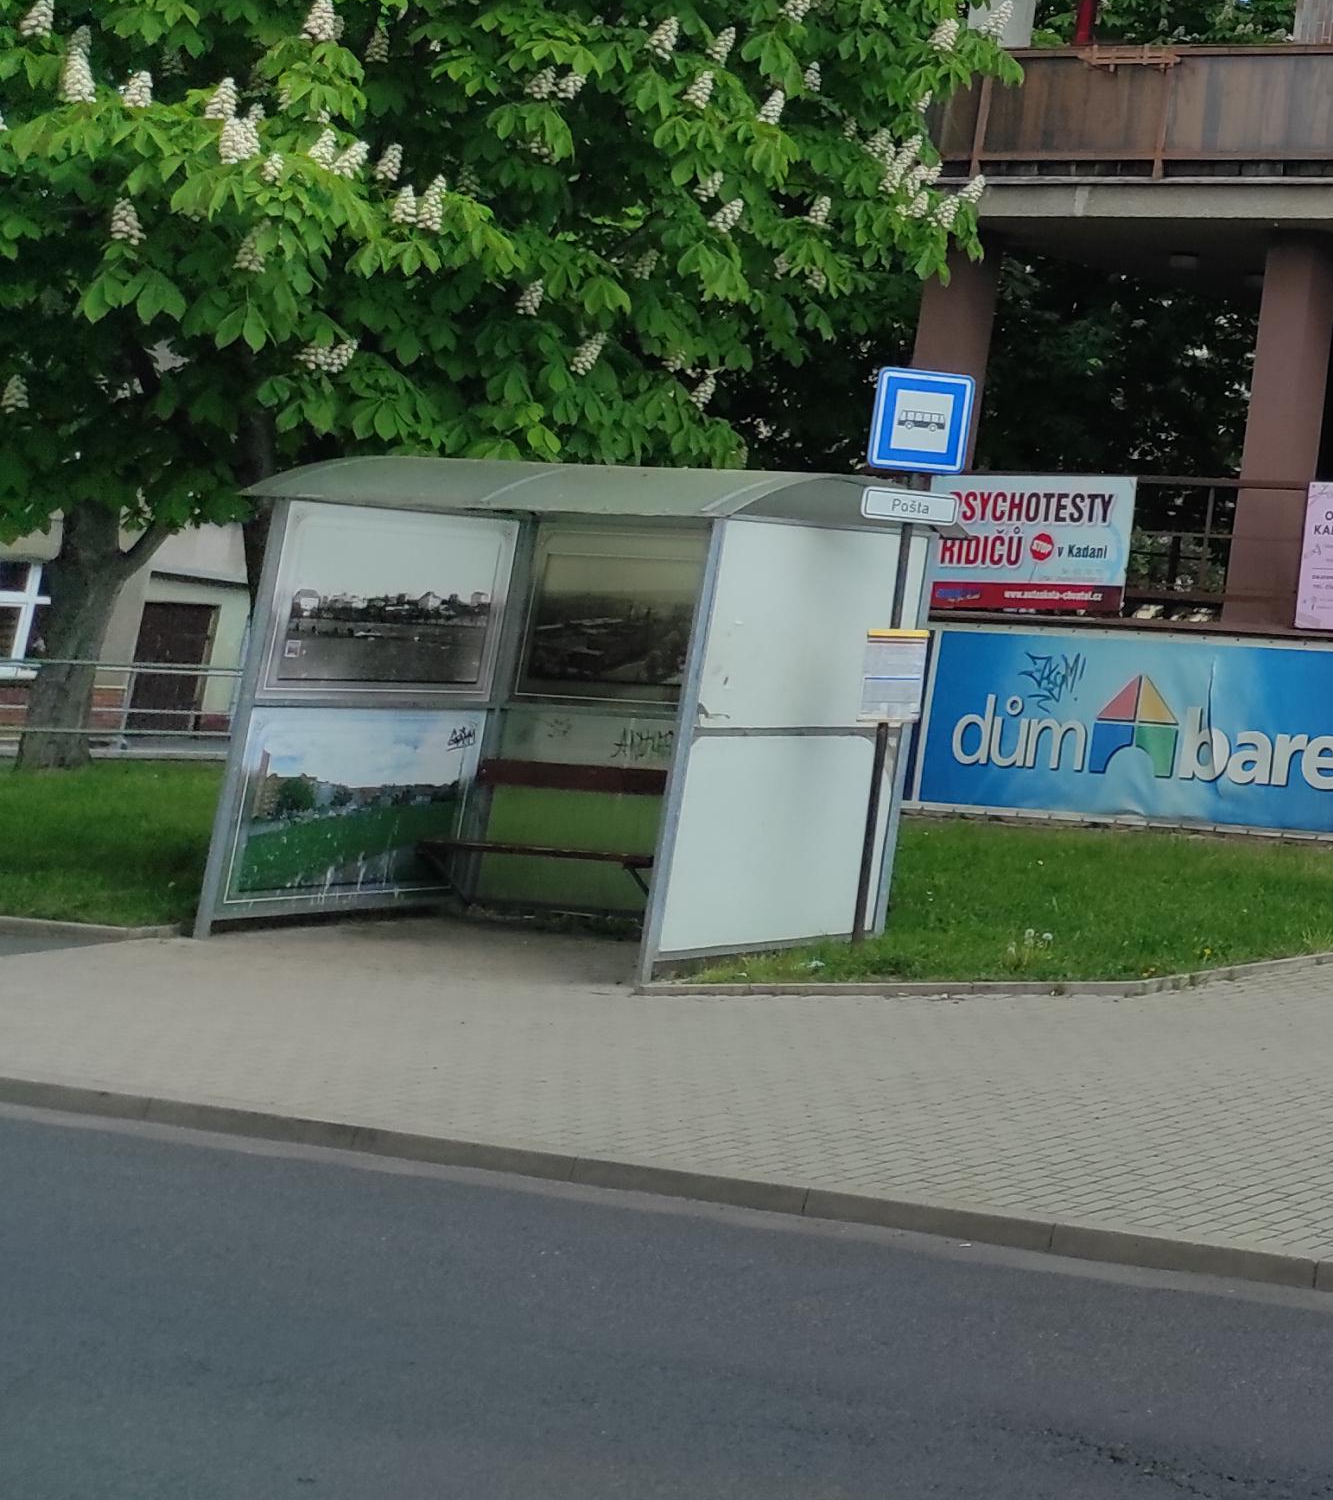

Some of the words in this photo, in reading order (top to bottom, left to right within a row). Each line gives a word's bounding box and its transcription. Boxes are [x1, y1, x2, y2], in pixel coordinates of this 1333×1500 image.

[891, 498, 930, 515] Pošta
[1057, 546, 1064, 558] v
[952, 694, 1087, 772] dům
